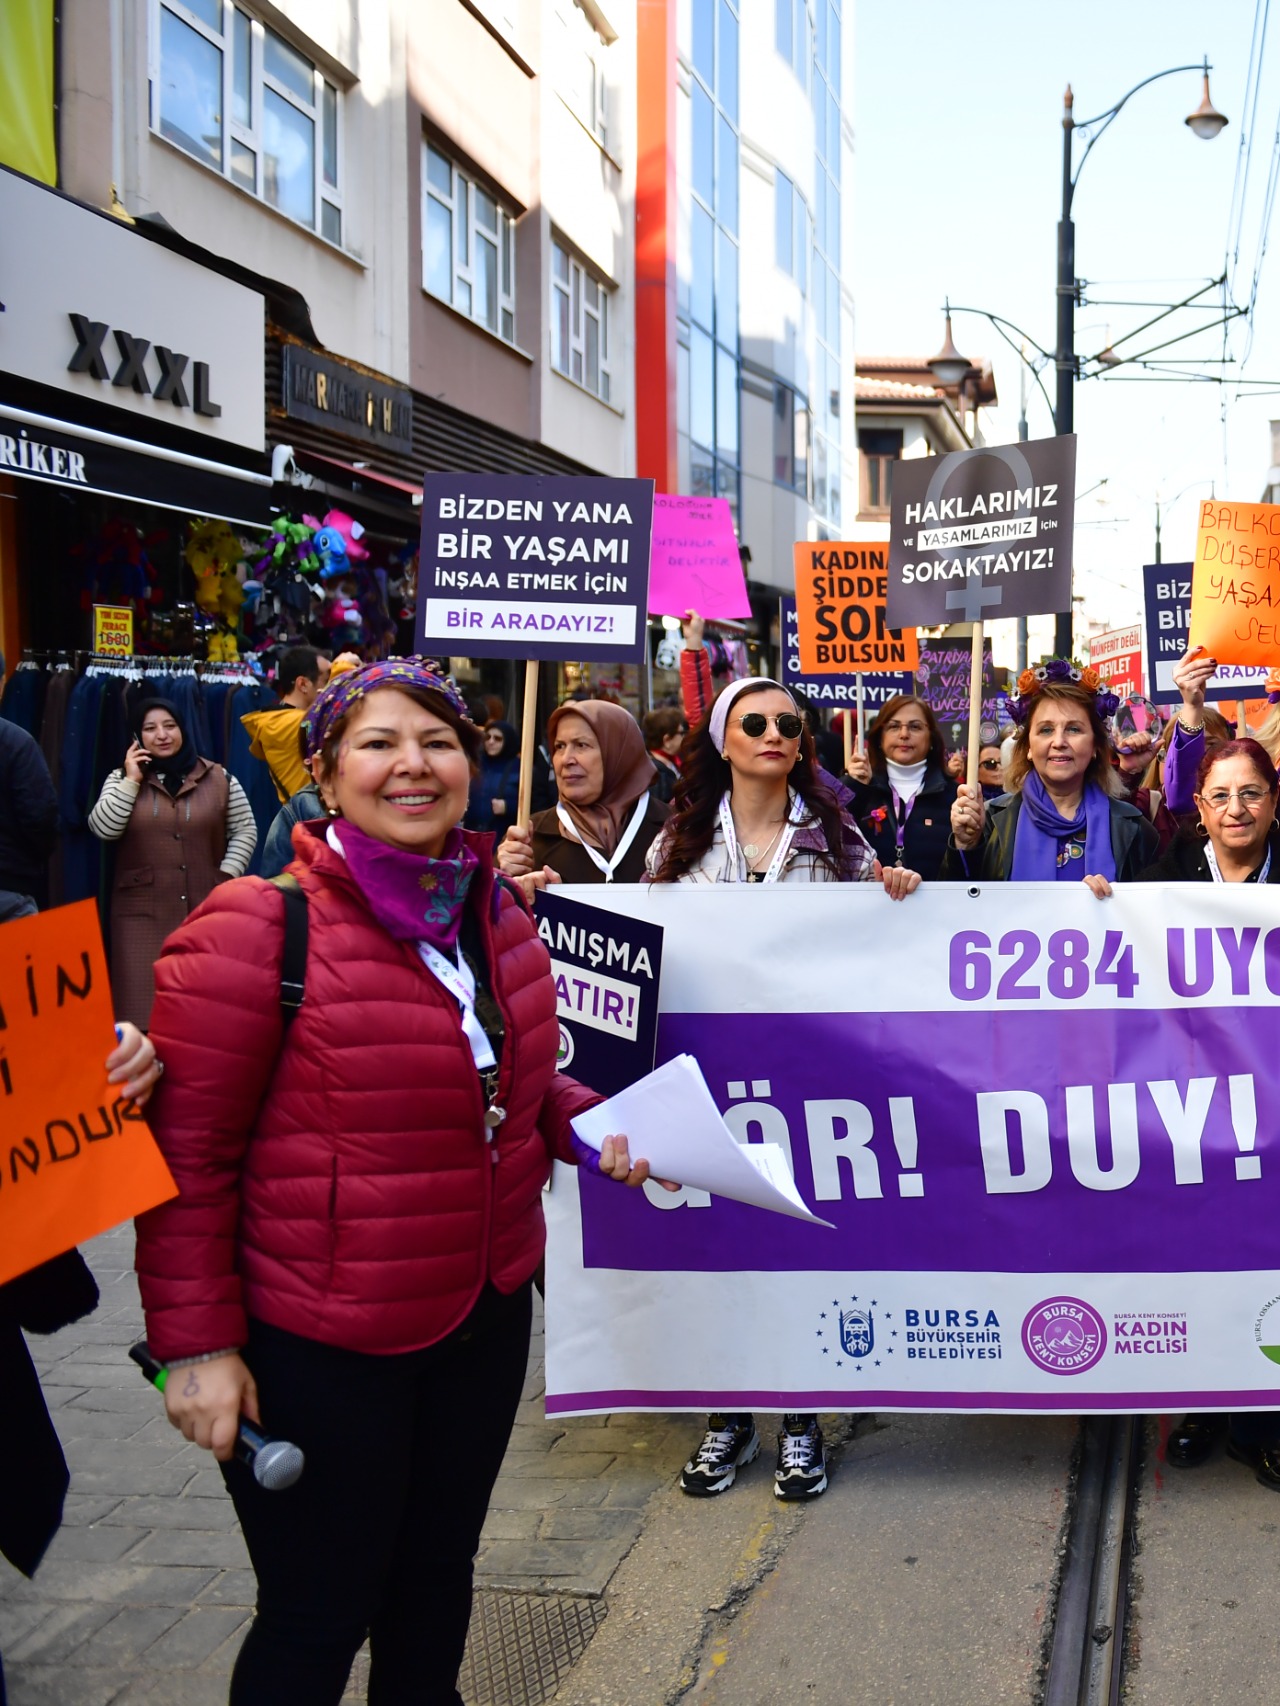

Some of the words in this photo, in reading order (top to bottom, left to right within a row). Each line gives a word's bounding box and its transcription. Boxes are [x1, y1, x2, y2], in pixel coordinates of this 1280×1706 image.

[67, 313, 222, 418] XXXL
[294, 363, 366, 426] MARMARA
[438, 494, 543, 521] BİZDEN
[552, 501, 633, 524] YANA
[905, 484, 1058, 525] HAKLARIMIZ
[903, 538, 914, 547] VE
[922, 521, 1032, 547] YAŞAMLARIMIZ
[1040, 519, 1058, 530] İÇİN
[437, 528, 492, 560] BİR
[503, 535, 629, 566] YAŞAMI
[811, 551, 889, 570] KADIN
[901, 548, 1054, 584] SOKAKTAYIZ!
[434, 567, 501, 590] İNŞAA
[507, 573, 578, 591] ETMEK
[584, 572, 628, 595] İÇİN
[446, 608, 484, 628] BİR
[490, 612, 614, 633] ARADAYIZ!
[815, 604, 902, 642] SON
[816, 643, 905, 664] BULSUN
[1090, 635, 1119, 657] MÜNFERİT
[1120, 631, 1140, 649] DEĞİL
[1099, 656, 1131, 678] DEVLET
[533, 914, 654, 979] ANIŞMA
[948, 928, 1140, 1001] 6284
[976, 1073, 1263, 1195] DUY!
[905, 1309, 1000, 1328] BURSA
[1042, 1306, 1084, 1322] BURSA
[1157, 1311, 1187, 1319] KONSEYİ
[906, 1328, 1001, 1346] BÜYÜKŞEHİR
[1114, 1321, 1187, 1337] KADIN
[1254, 1318, 1263, 1342] BURSA
[907, 1344, 1002, 1360] BELEDİYESİ
[1032, 1335, 1056, 1363] KENT
[1057, 1334, 1097, 1367] KONSEYİ
[1114, 1338, 1188, 1355] MECLİSİ
